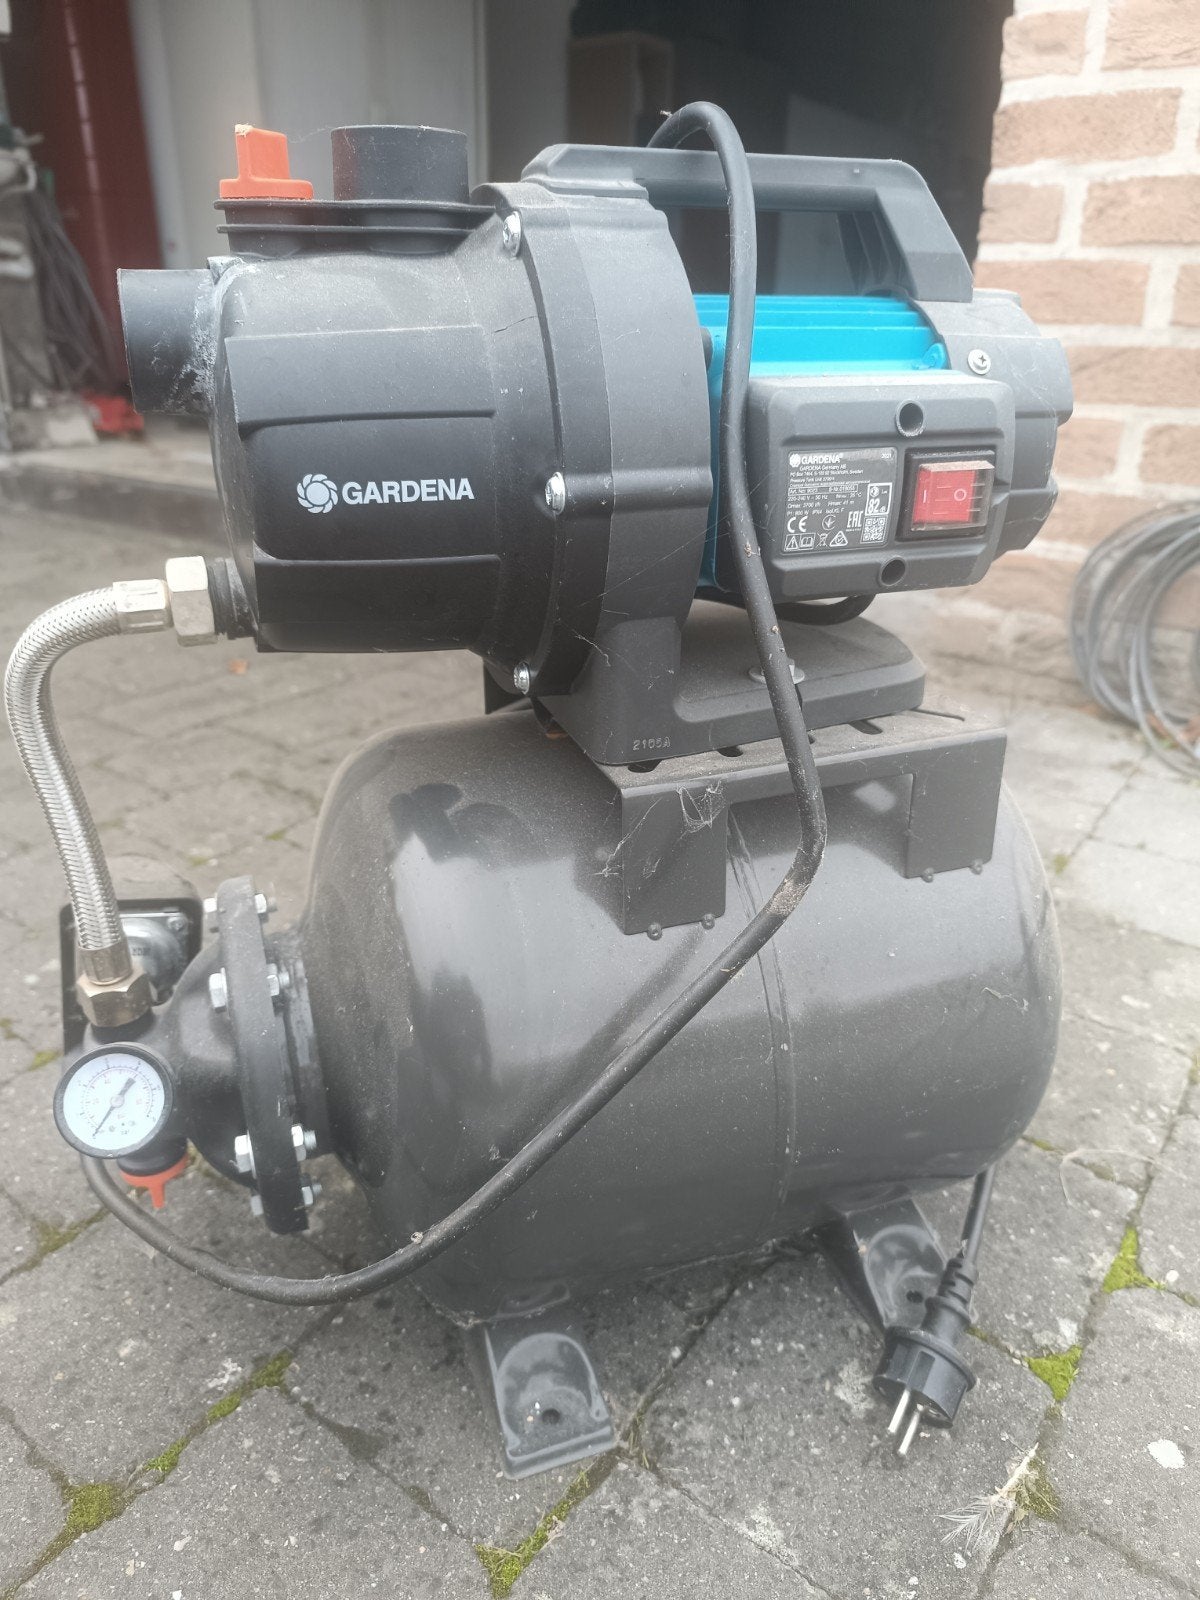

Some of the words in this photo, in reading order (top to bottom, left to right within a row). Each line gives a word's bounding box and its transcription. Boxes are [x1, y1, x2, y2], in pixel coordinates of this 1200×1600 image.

[341, 477, 475, 505] GARDENA
[867, 498, 880, 514] 82
[787, 516, 808, 533] CE
